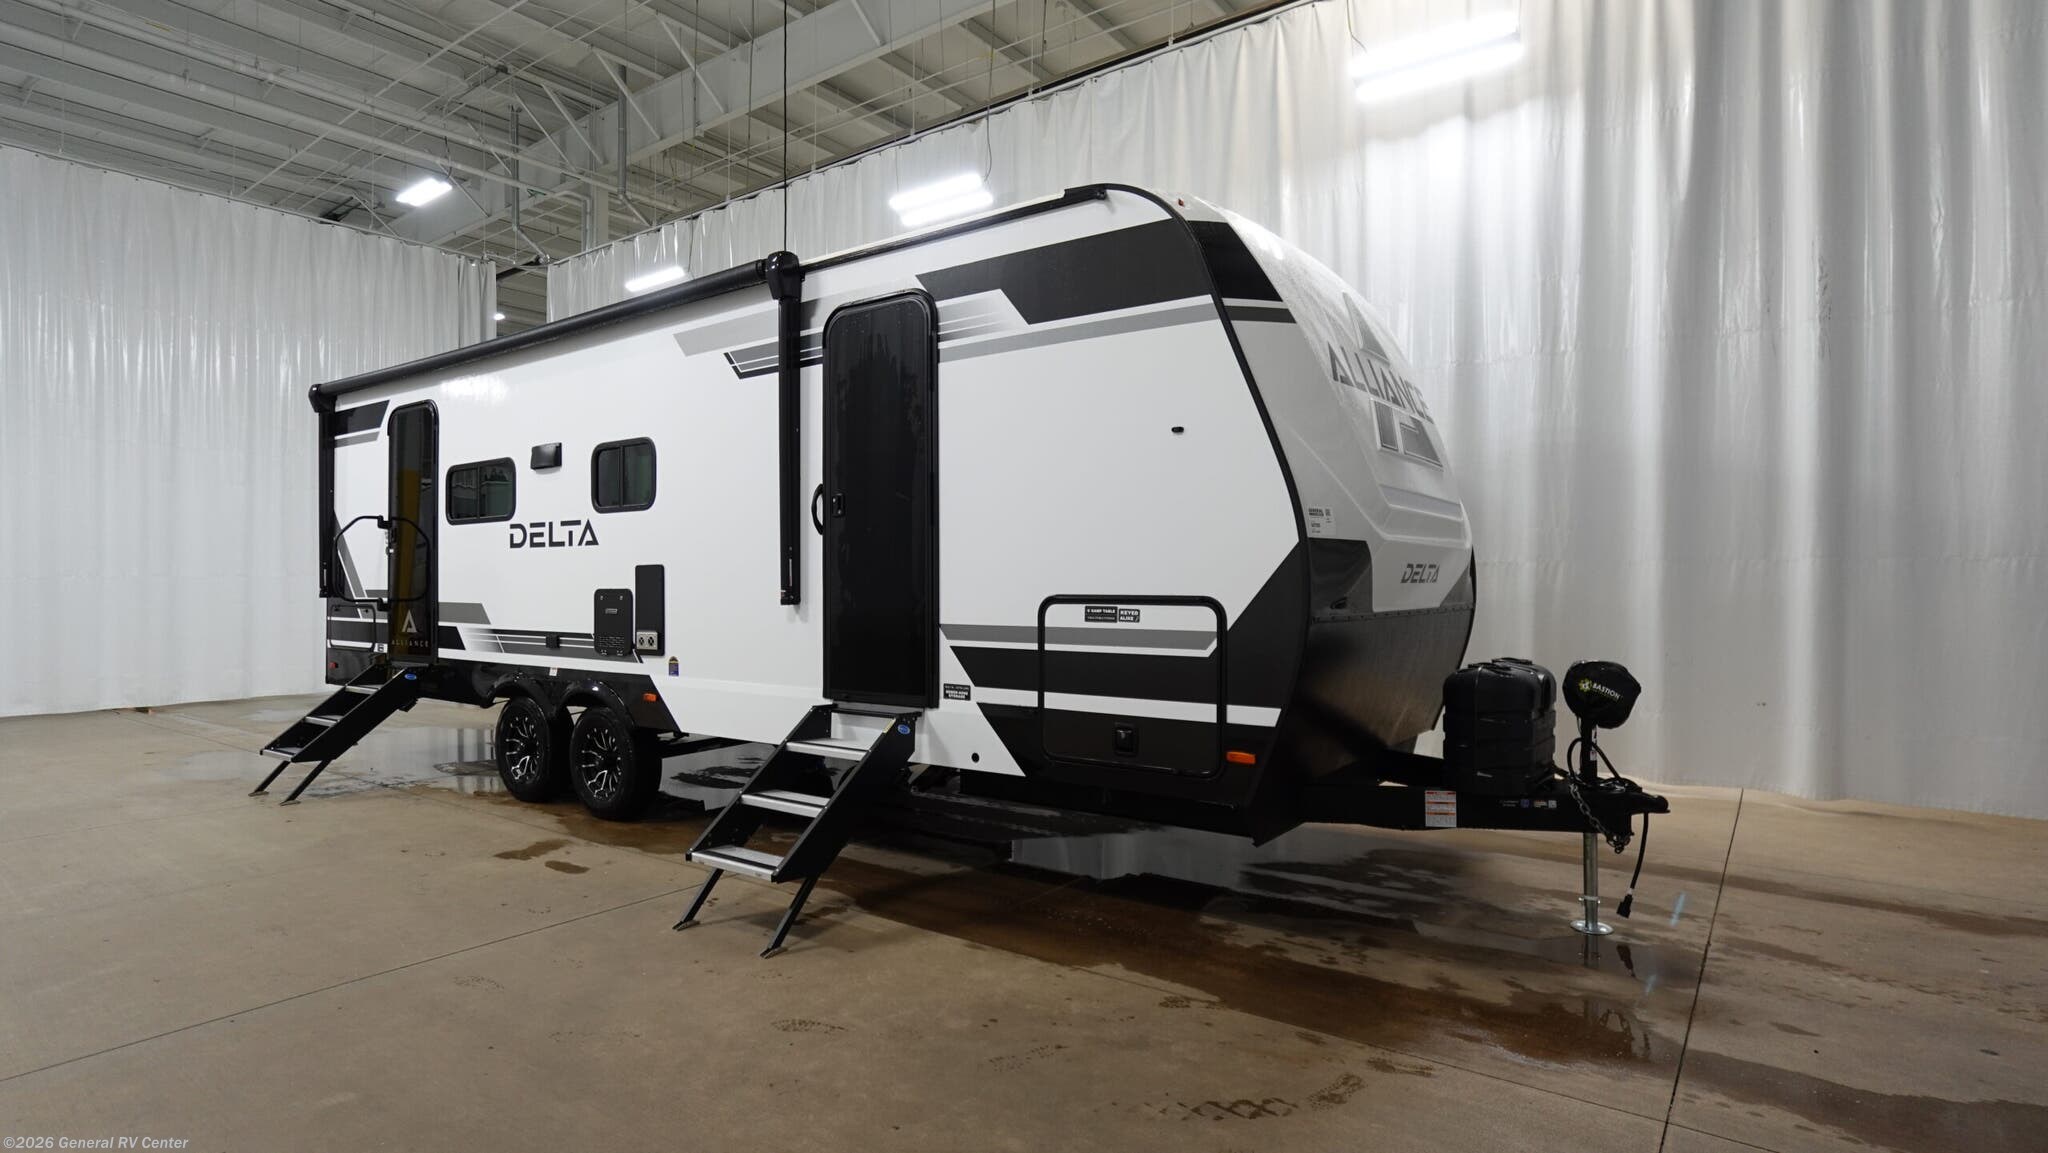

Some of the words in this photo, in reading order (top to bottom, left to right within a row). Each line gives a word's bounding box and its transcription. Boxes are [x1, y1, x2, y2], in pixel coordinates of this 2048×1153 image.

[1327, 341, 1434, 425] ALLIANCE
[509, 518, 599, 549] DELTA
[1401, 563, 1440, 584] DELTA
[1592, 682, 1621, 700] BASTION
